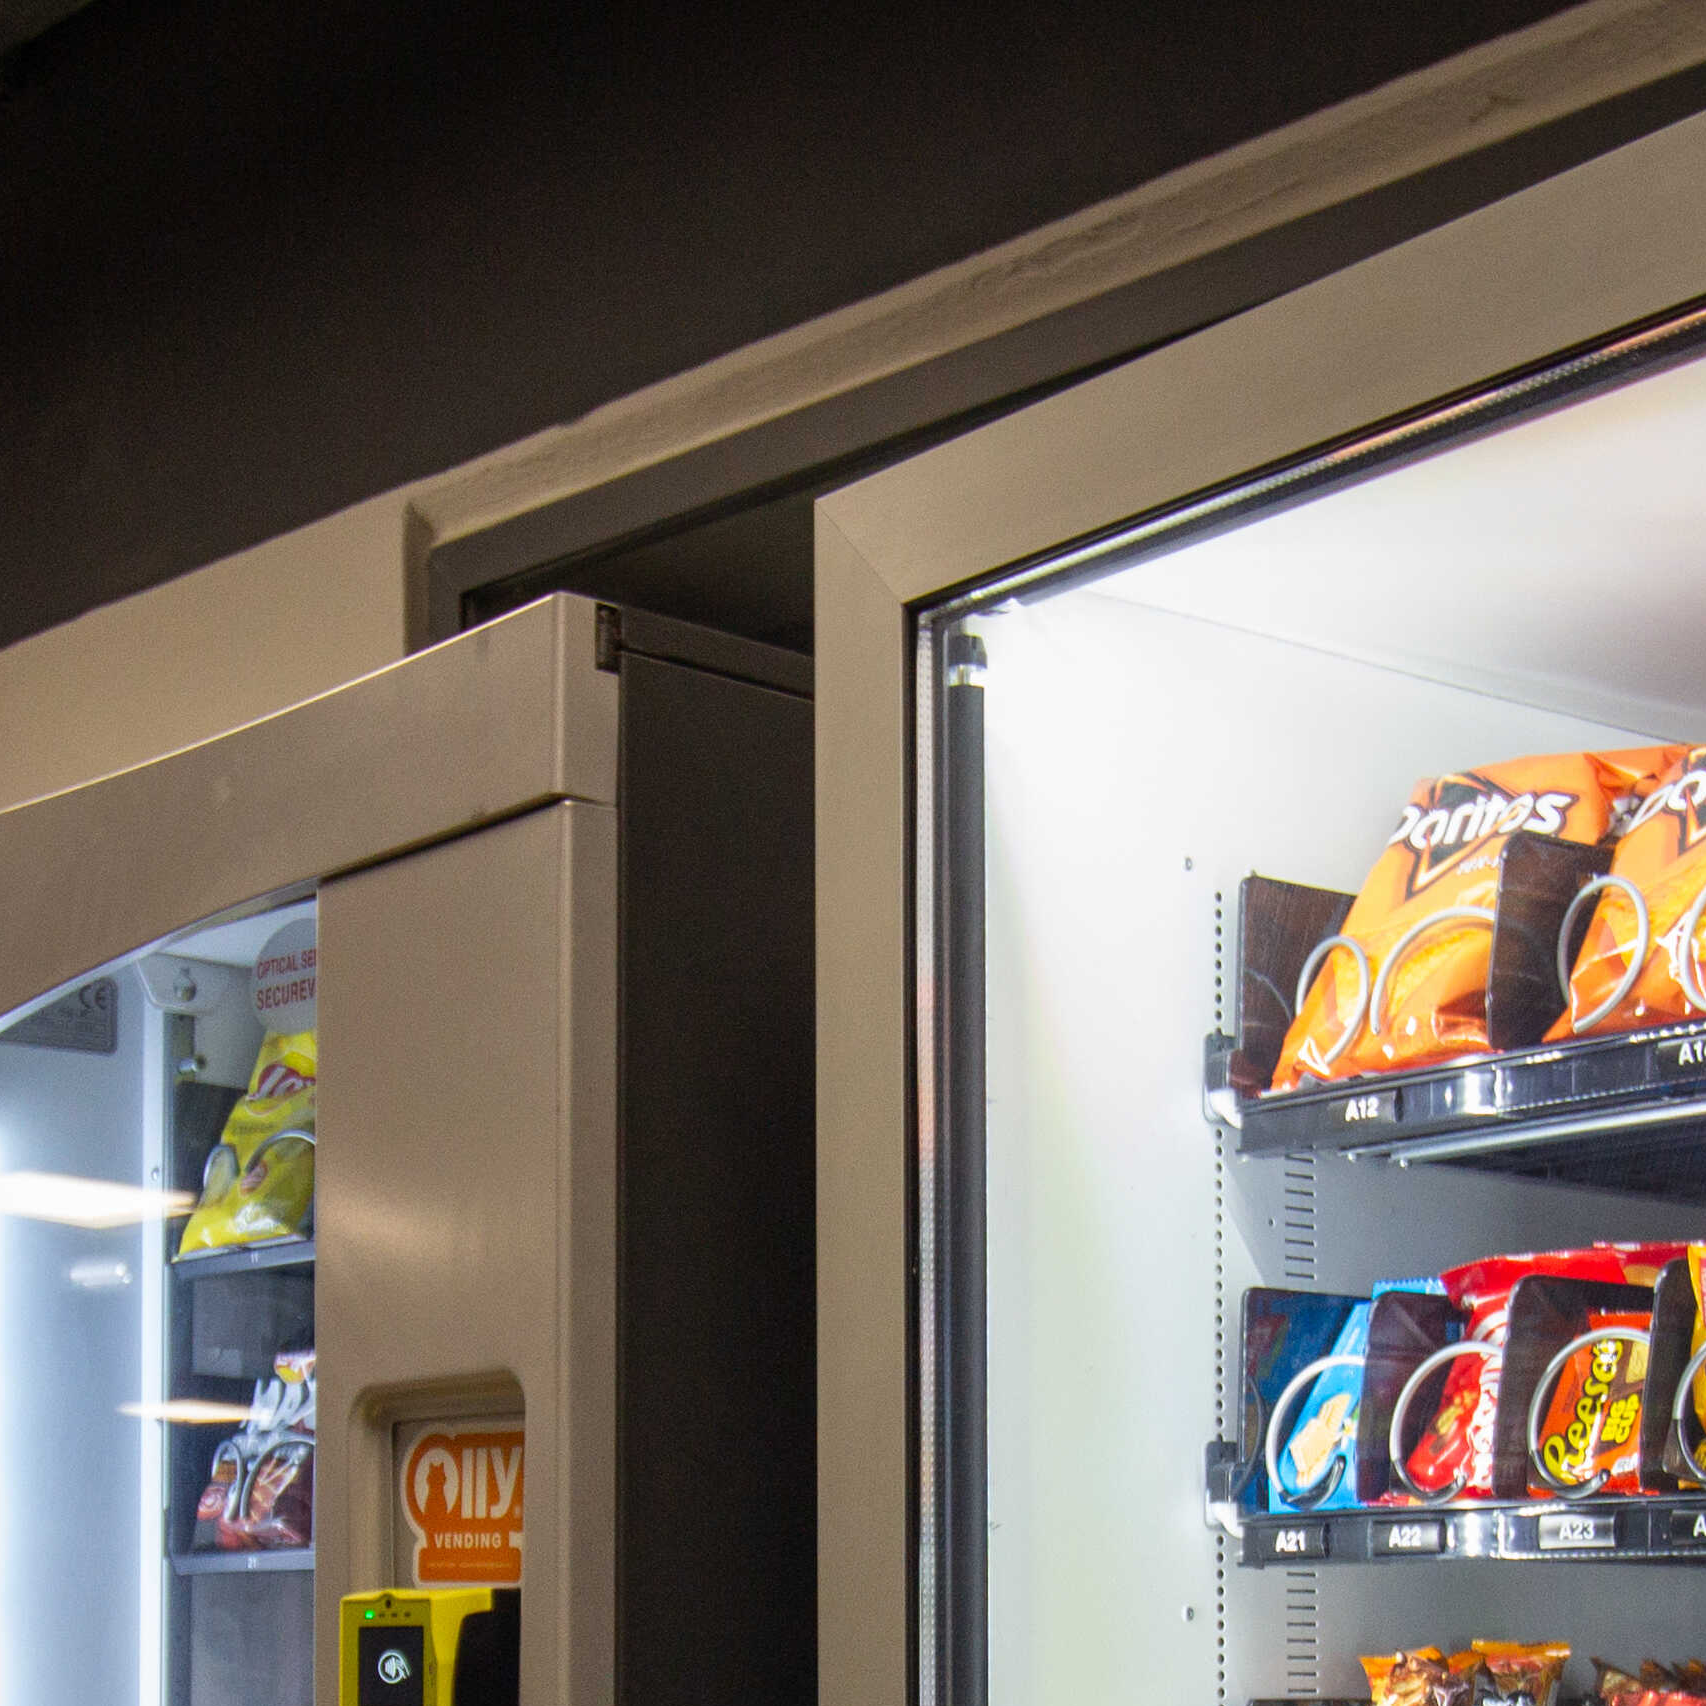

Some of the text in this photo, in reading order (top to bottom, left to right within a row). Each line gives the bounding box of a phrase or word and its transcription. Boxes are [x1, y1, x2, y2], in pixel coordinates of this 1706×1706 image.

[256, 954, 298, 980] OPTICAL
[1344, 1097, 1380, 1122] A12
[433, 1532, 502, 1549] VENDING
[1389, 1526, 1422, 1547] A22
[1559, 1519, 1595, 1541] A23
[1275, 1531, 1307, 1552] A21
